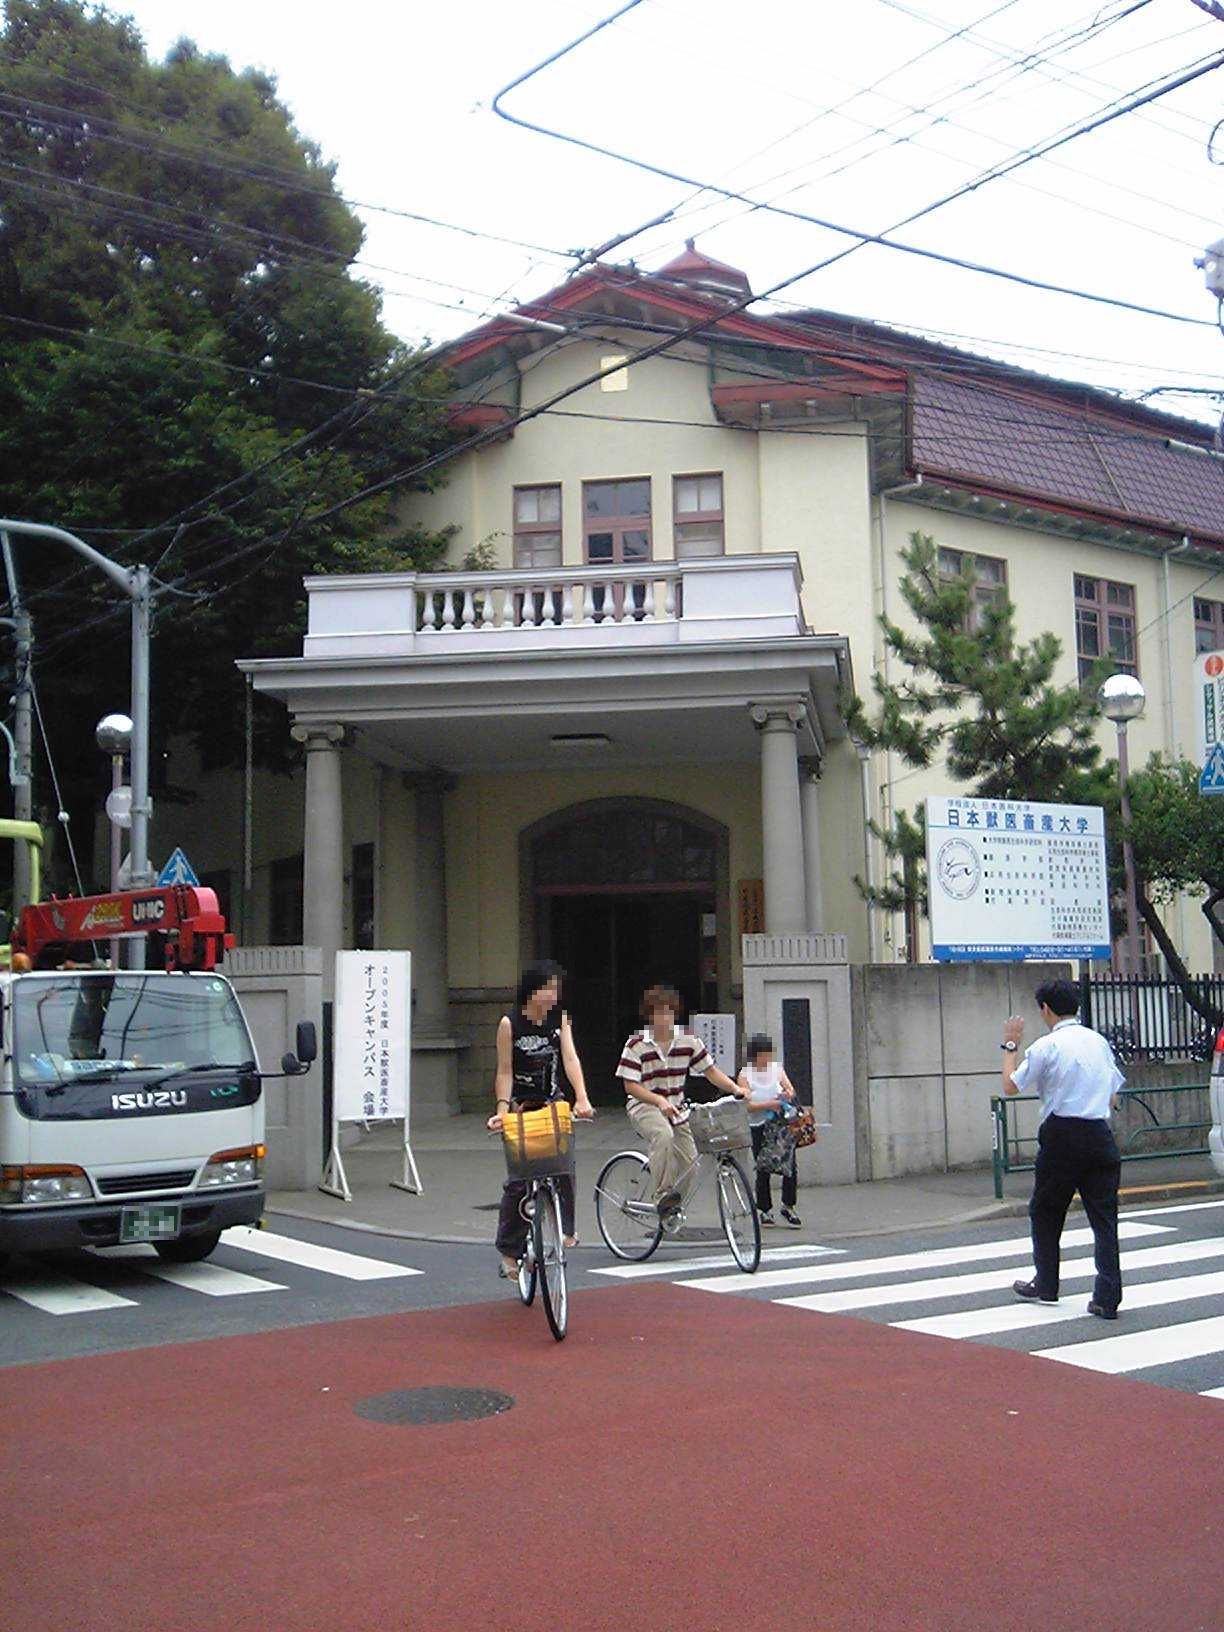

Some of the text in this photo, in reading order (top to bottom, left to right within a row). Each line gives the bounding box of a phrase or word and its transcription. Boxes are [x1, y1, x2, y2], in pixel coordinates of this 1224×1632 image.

[132, 900, 165, 921] UNIC
[363, 964, 376, 1116] オープンキャンパス 会場
[112, 1090, 187, 1110] ISUZU
